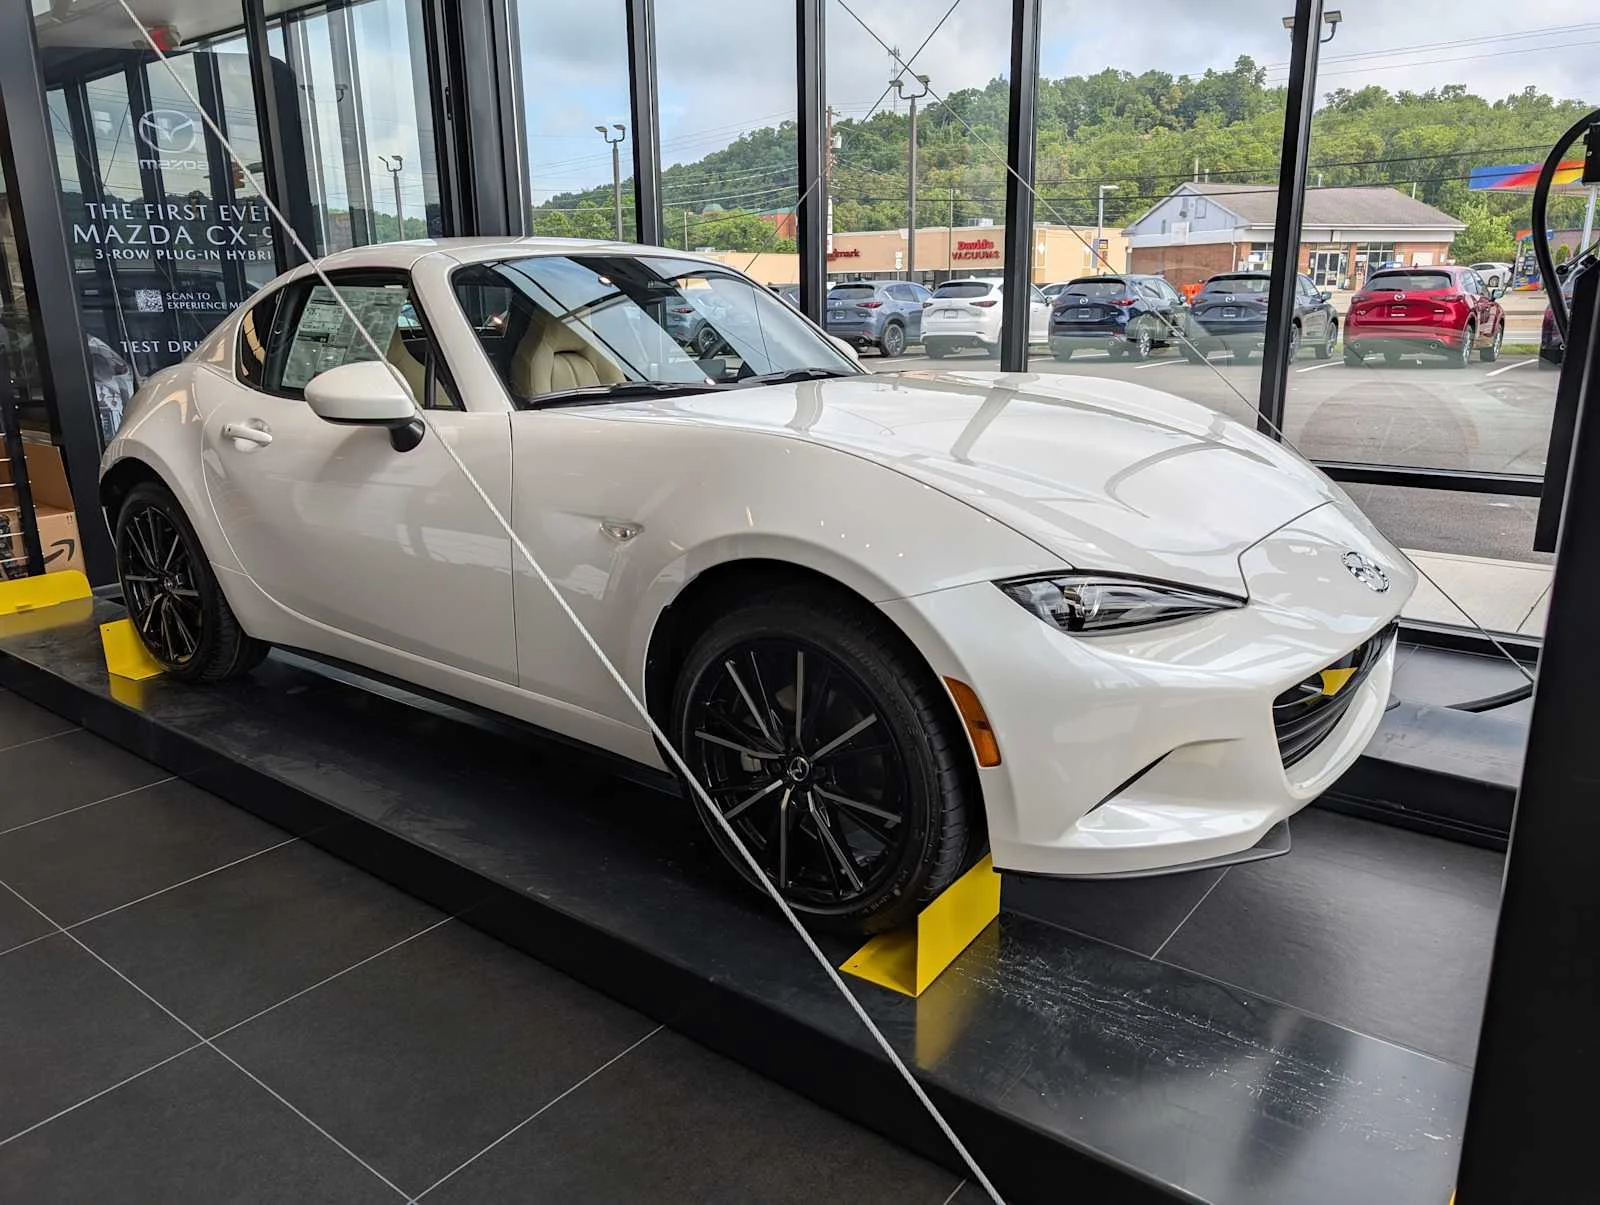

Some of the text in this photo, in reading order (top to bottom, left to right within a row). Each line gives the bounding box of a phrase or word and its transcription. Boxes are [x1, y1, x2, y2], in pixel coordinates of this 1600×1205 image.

[85, 203, 135, 220] THE
[144, 203, 207, 221] FIRST
[73, 224, 194, 245] MAZDA
[95, 249, 150, 260] 3-ROW
[156, 249, 221, 261] PLUG-IN
[951, 250, 1000, 260] VACUUMS
[166, 292, 211, 300] SCAN TO
[167, 301, 228, 310] EXPERIENCE
[120, 340, 160, 353] TEST
